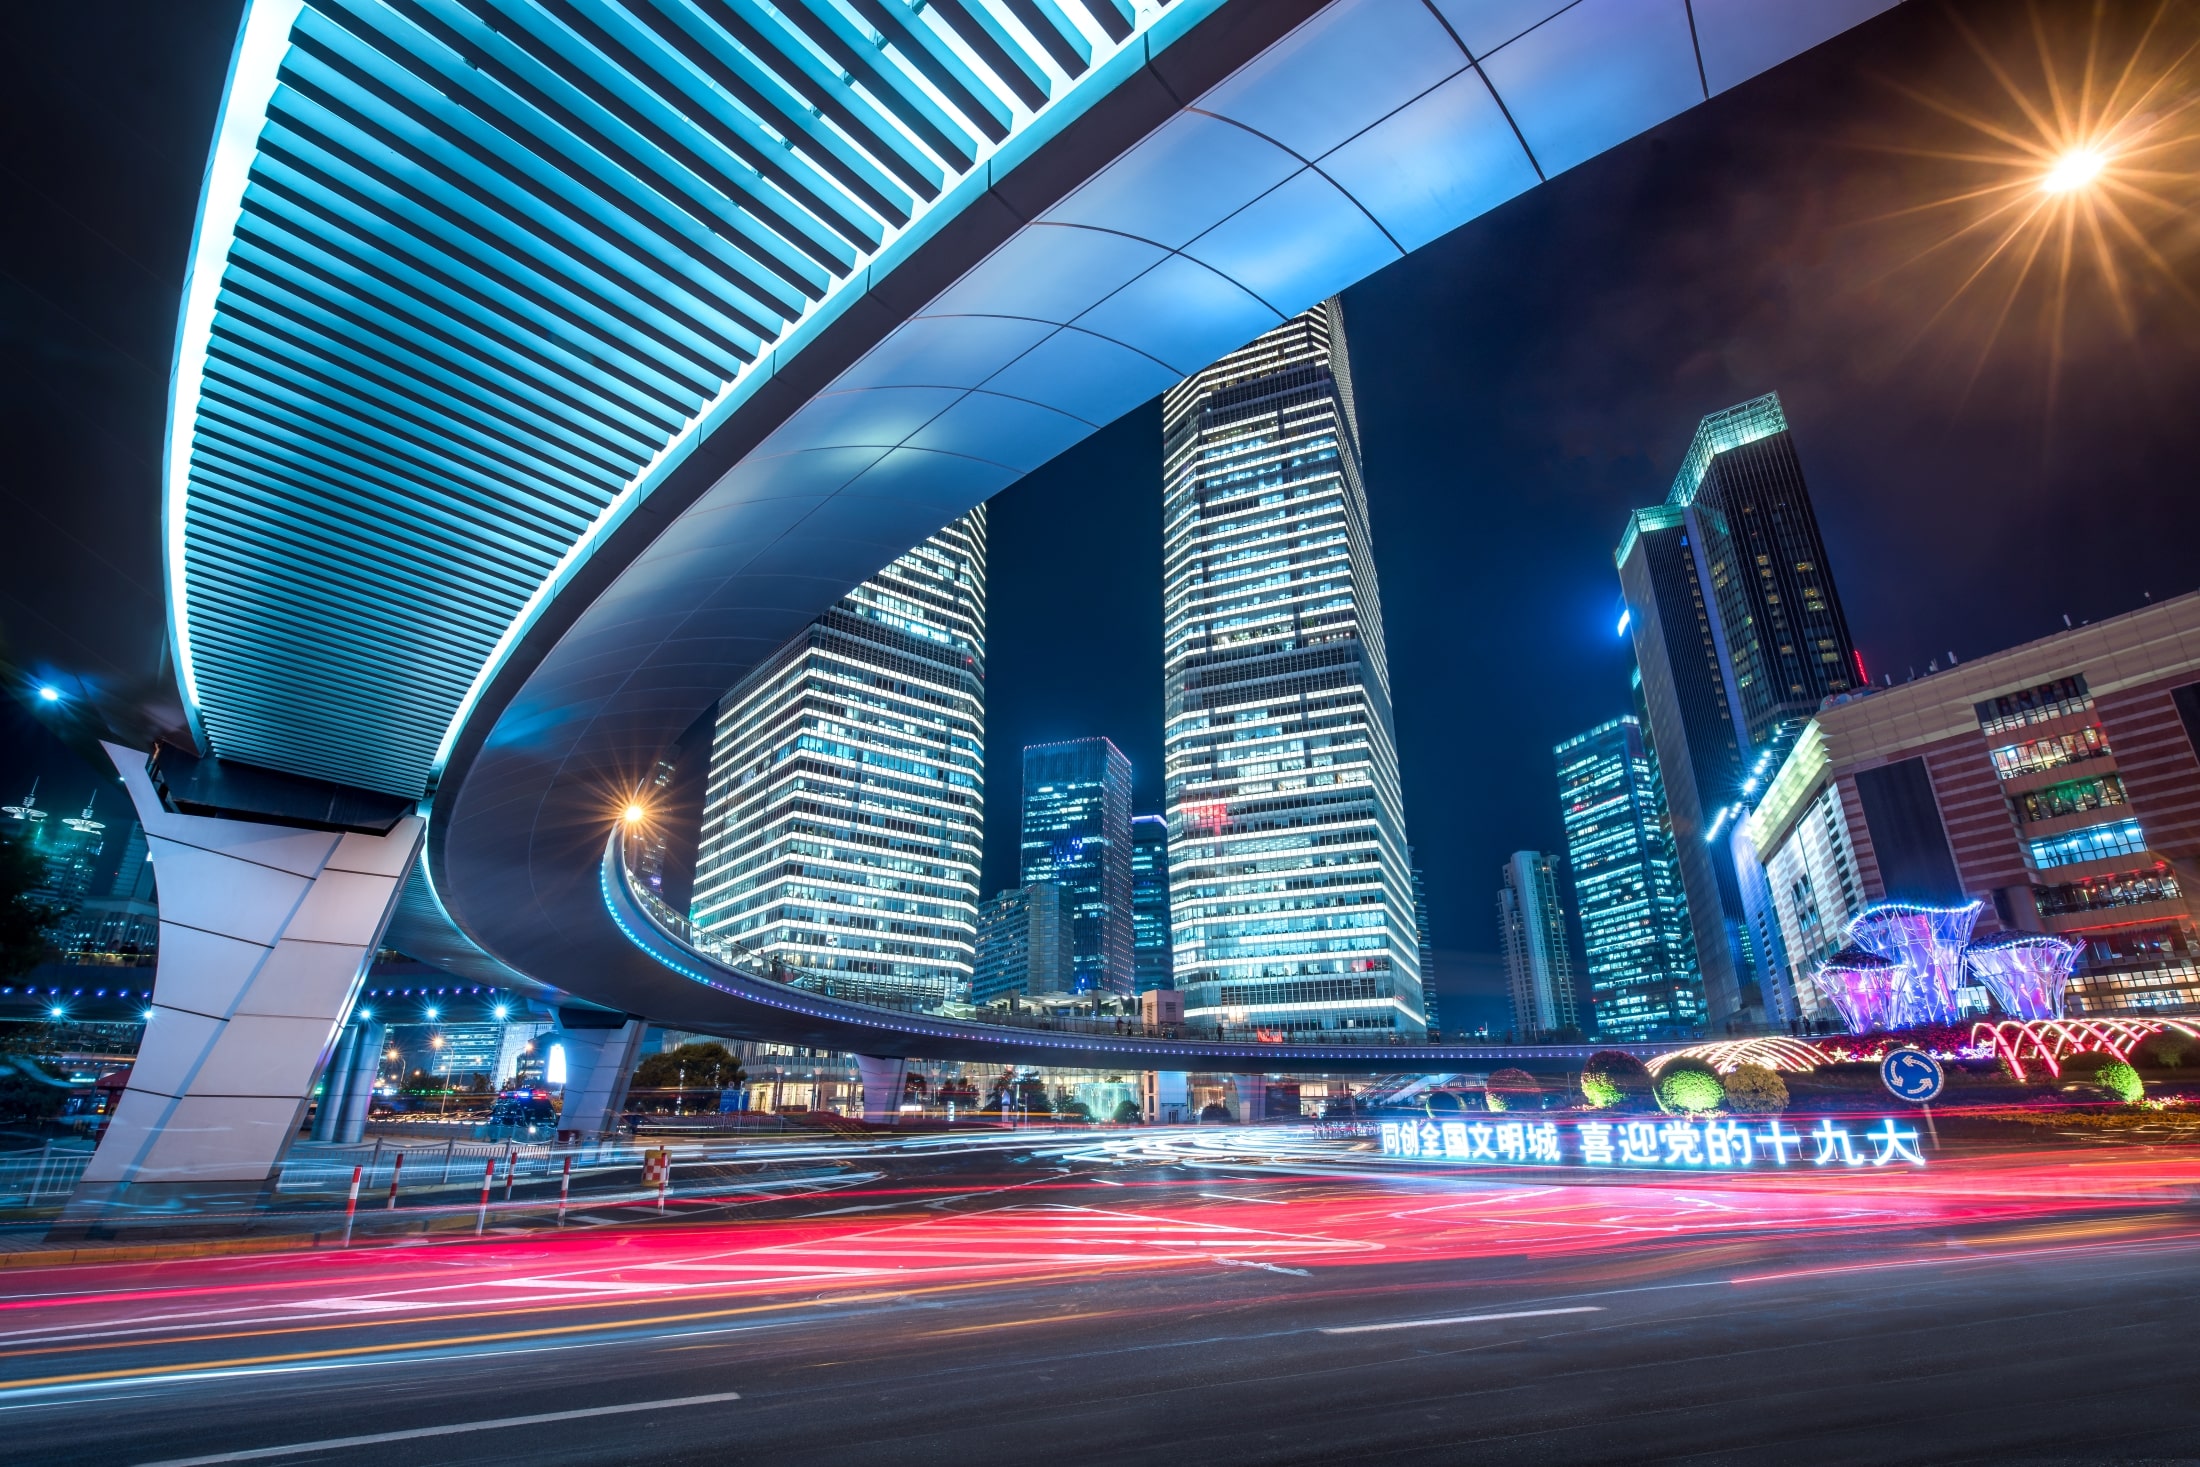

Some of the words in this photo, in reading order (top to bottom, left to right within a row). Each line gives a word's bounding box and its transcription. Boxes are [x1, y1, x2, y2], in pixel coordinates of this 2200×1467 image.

[1382, 1120, 1561, 1161] 同创全国文明城
[1577, 1119, 1926, 1166] 喜迎党的十九大
